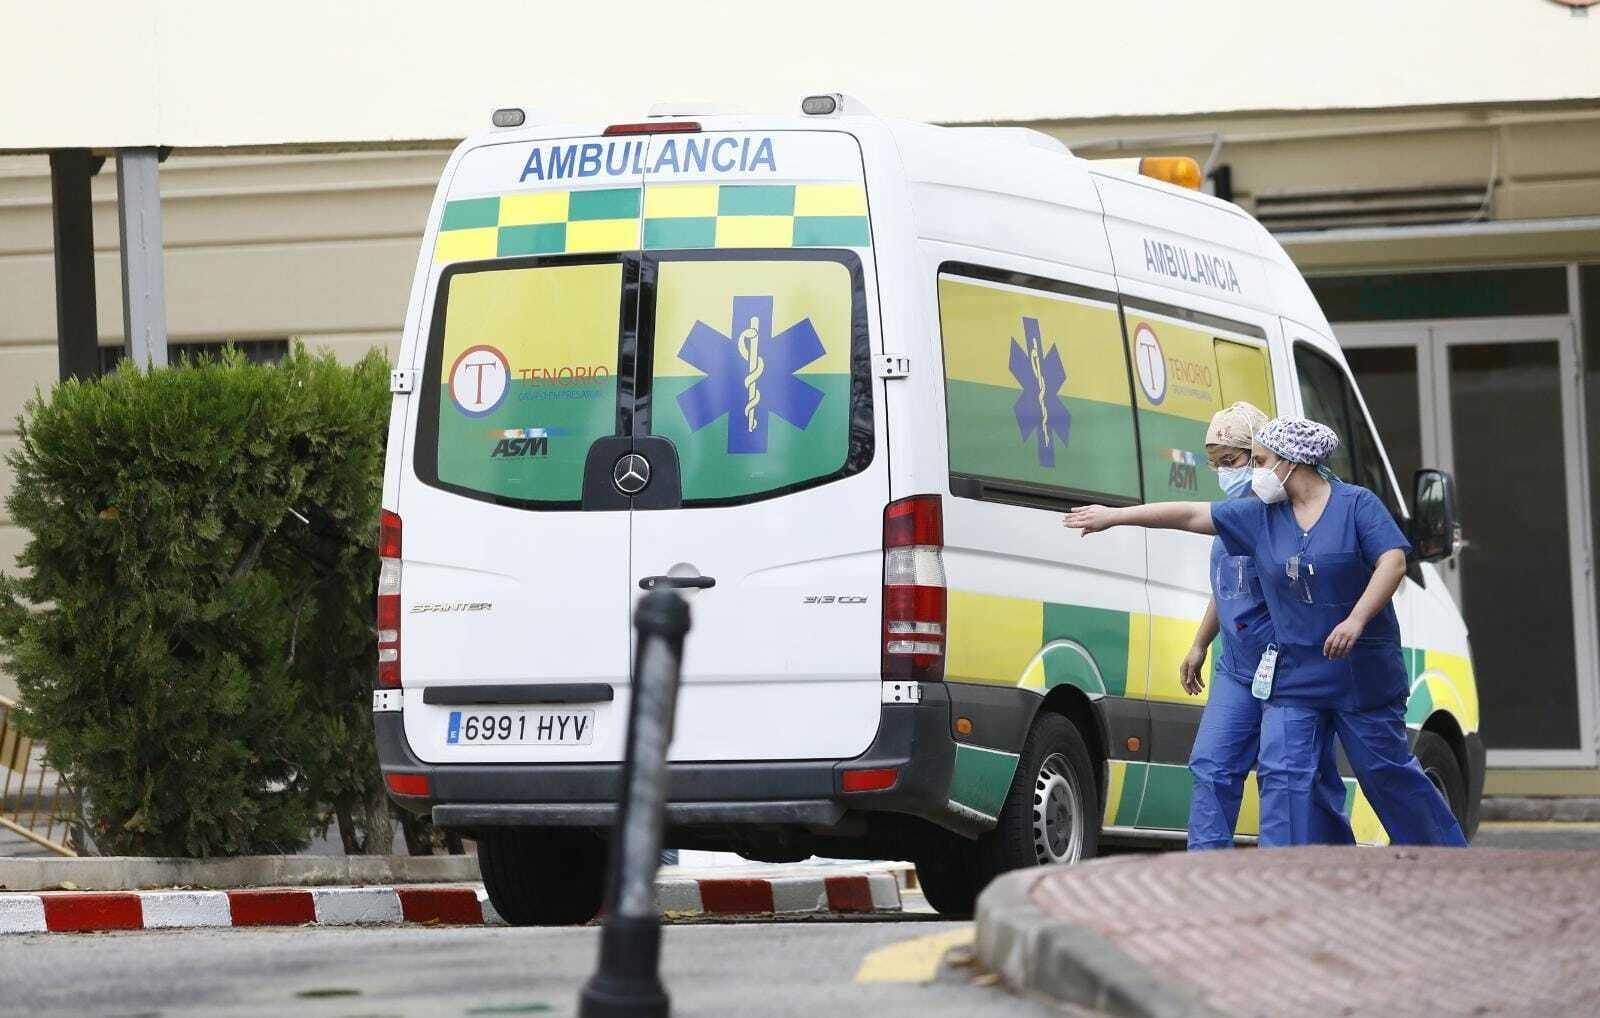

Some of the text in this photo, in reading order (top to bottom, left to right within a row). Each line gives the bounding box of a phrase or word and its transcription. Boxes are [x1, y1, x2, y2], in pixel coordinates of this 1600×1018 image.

[519, 137, 777, 183] AMBULANCIA
[1143, 238, 1242, 294] AMBULANCIA
[465, 361, 497, 404] T
[518, 365, 609, 388] TENORIO
[490, 437, 548, 458] ASM
[465, 716, 526, 740] 6991
[537, 716, 587, 740] HYV
